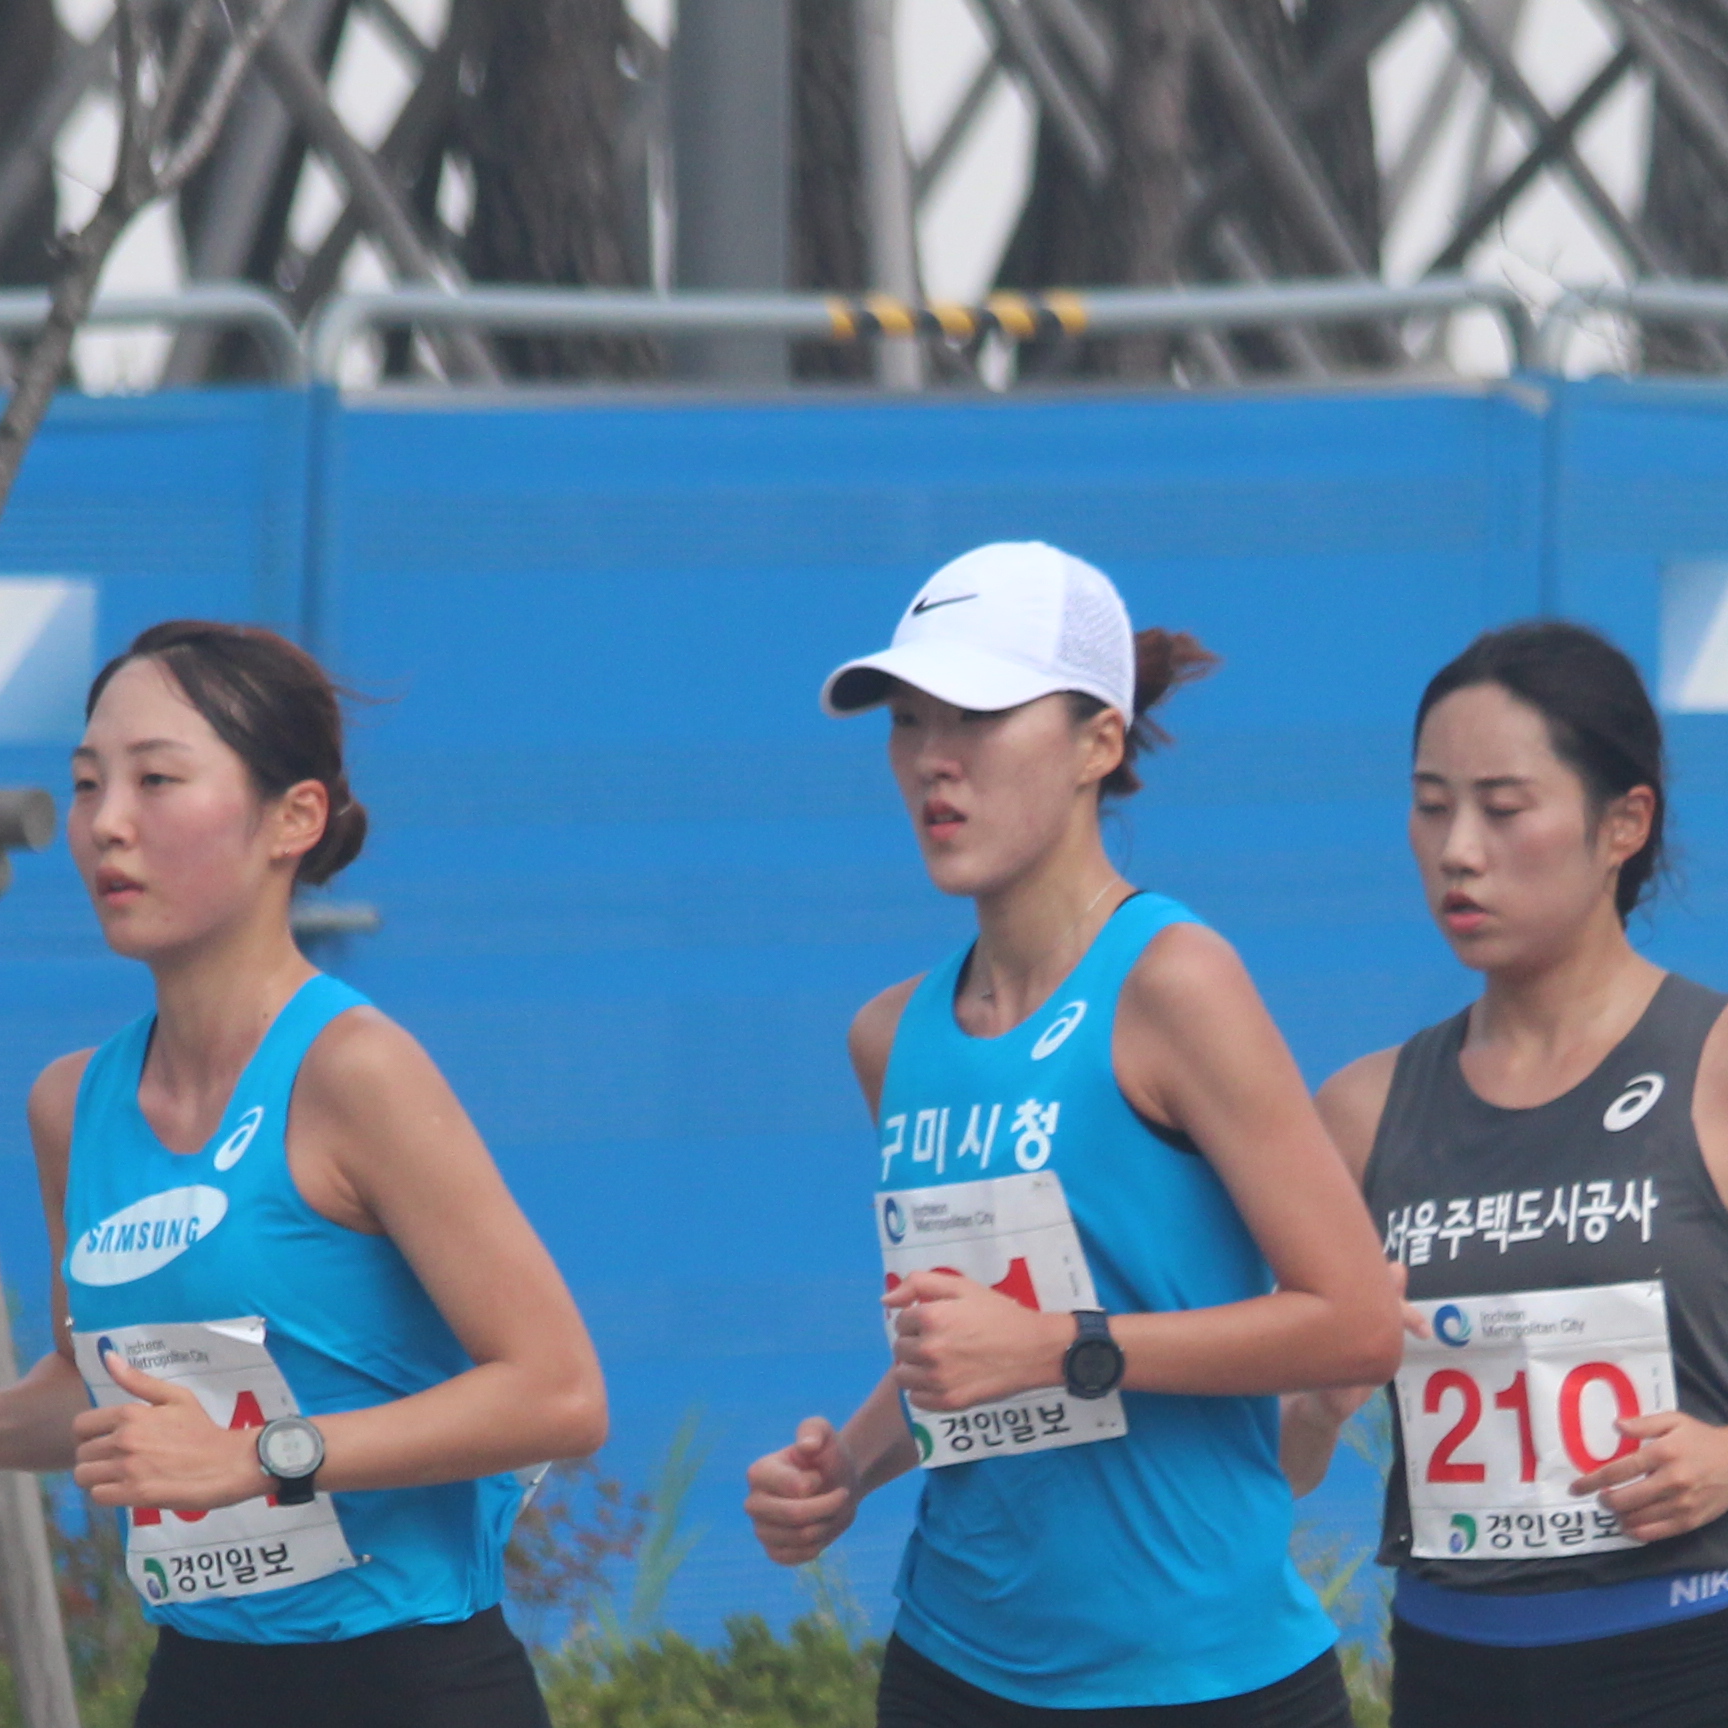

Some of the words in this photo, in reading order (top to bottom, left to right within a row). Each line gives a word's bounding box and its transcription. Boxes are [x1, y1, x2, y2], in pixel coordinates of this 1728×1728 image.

[881, 1098, 1061, 1183] 구미시청
[86, 1216, 201, 1254] SAMSUNG
[1383, 1175, 1660, 1267] 서울주택도시공사
[939, 1401, 1071, 1452] 경인일보
[1424, 1361, 1642, 1483] 210
[169, 1542, 294, 1593] 경인일보
